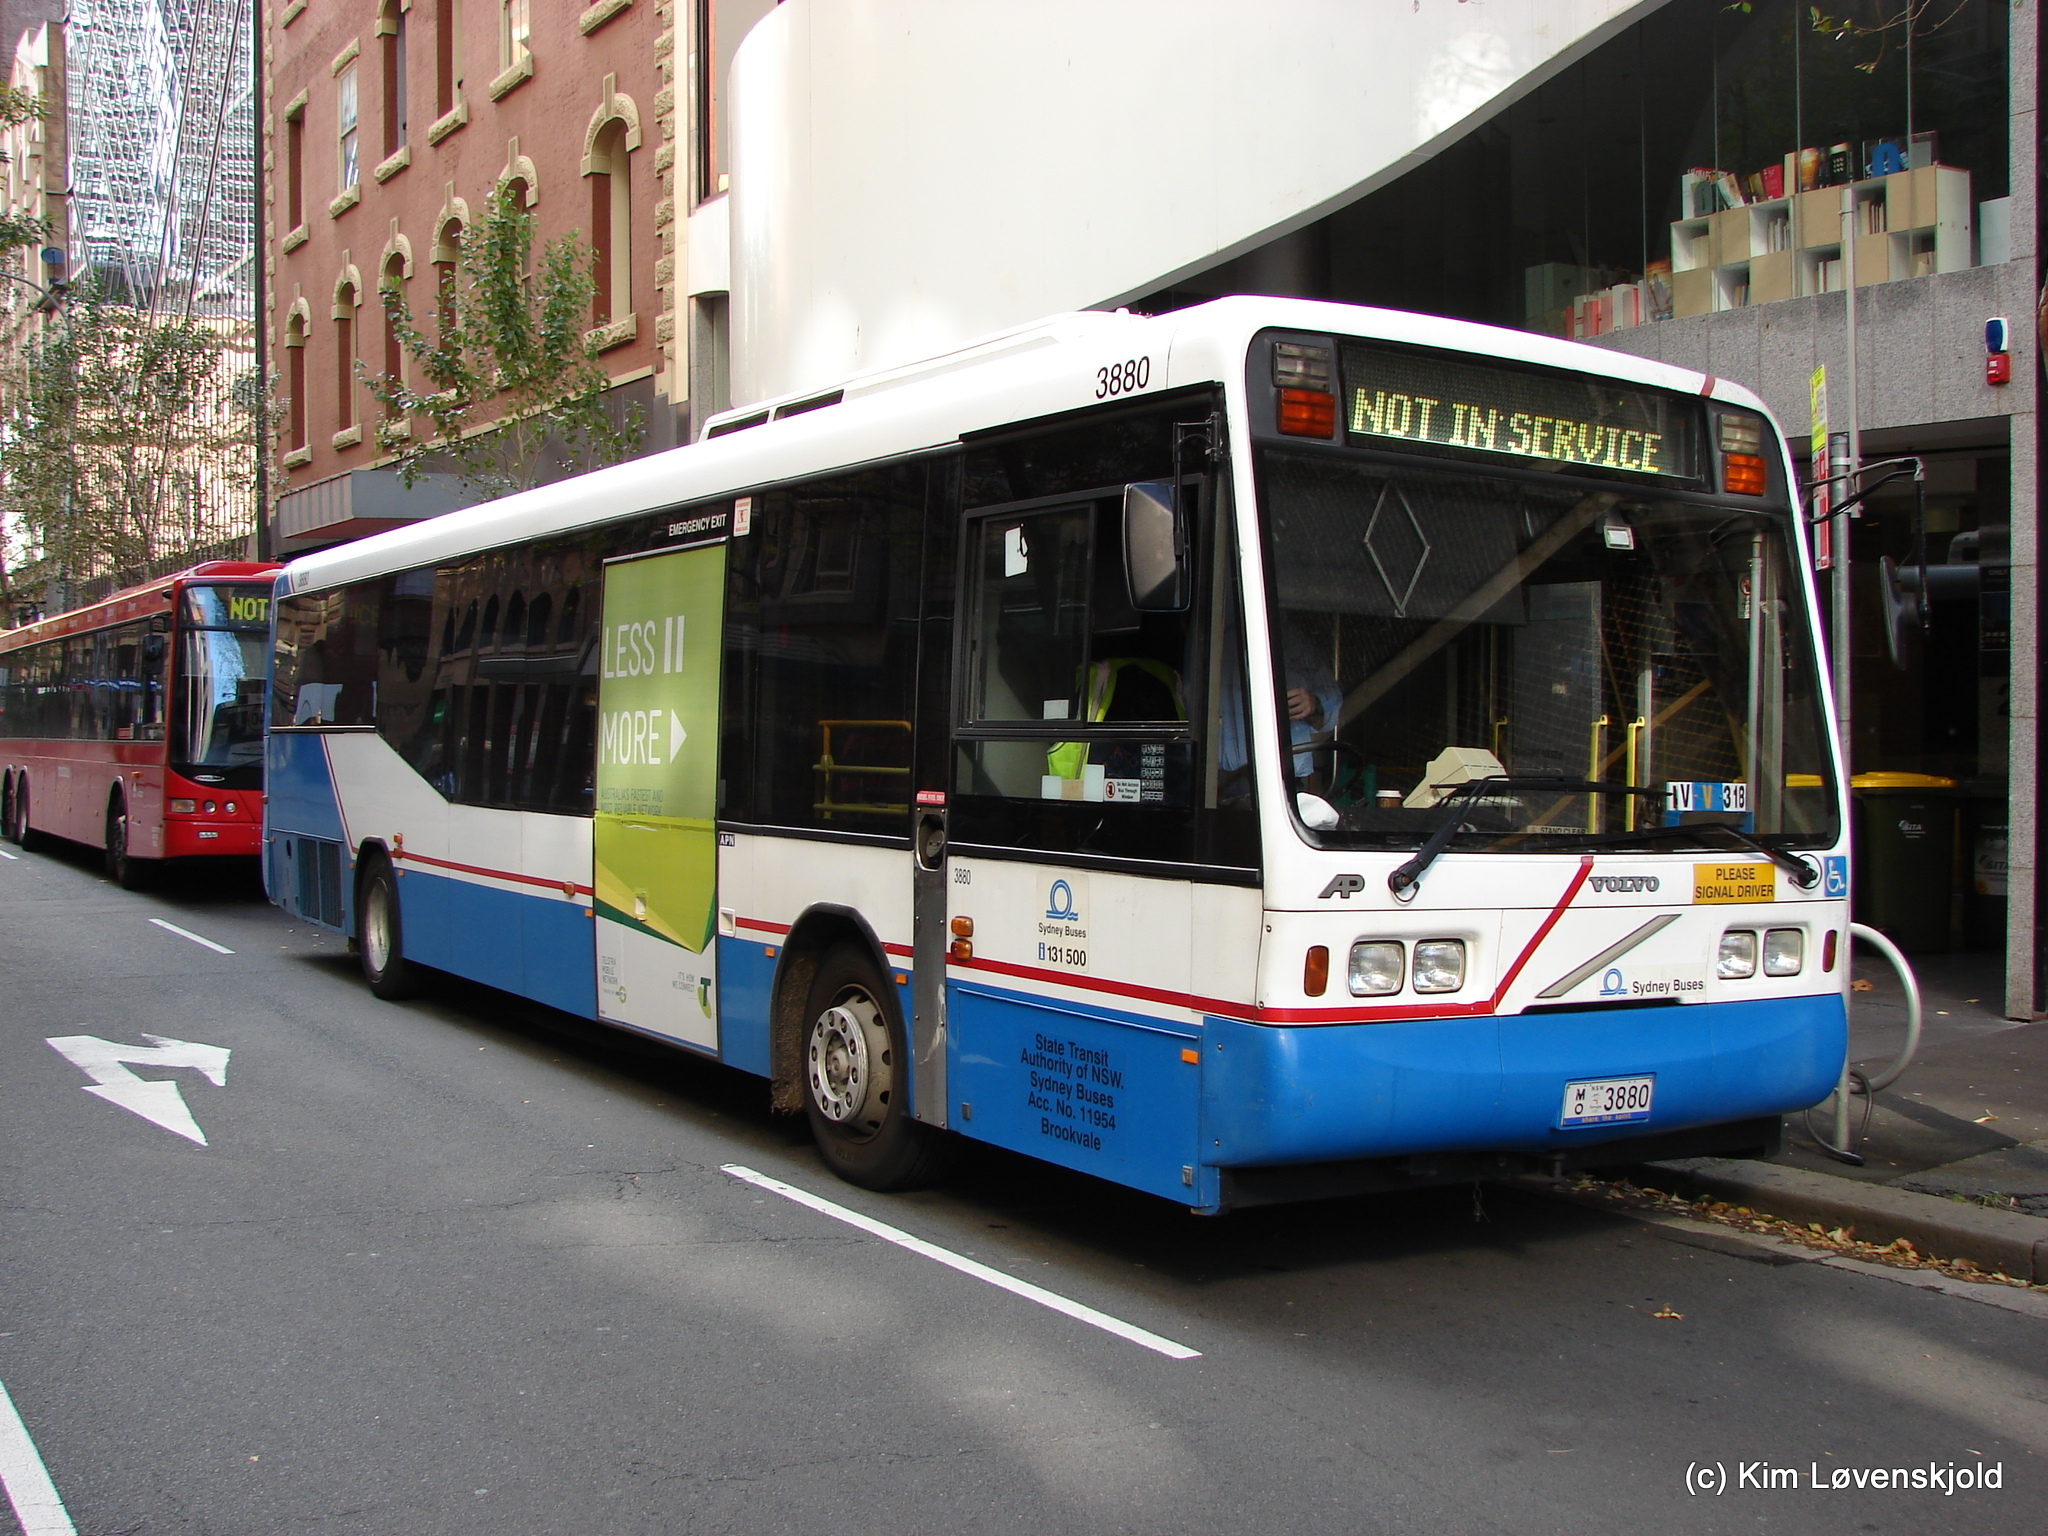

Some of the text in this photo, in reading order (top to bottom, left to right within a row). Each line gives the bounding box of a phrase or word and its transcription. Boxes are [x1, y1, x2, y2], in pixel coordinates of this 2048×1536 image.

[1095, 355, 1150, 399] 3880
[1352, 387, 1662, 473] NOT IN SERVICE
[669, 513, 727, 536] EMERGENCY EXIT
[229, 596, 269, 621] NOT
[603, 620, 656, 679] LESS
[601, 709, 662, 765] MORE
[1723, 785, 1745, 809] 318
[720, 835, 735, 846] APN
[954, 867, 971, 886] 3880
[1318, 874, 1365, 899] AP
[1589, 876, 1660, 893] VOLVO
[1716, 867, 1755, 881] PLEASE
[1695, 884, 1774, 899] SIGNAL DRIVER
[1038, 922, 1087, 938] Sydney Buses
[1047, 945, 1063, 963] 131
[1066, 948, 1087, 966] 500
[1632, 979, 1704, 997] Sydney Buses
[1035, 1033, 1109, 1067] State Transit
[1020, 1048, 1124, 1090] Authority of NSW.
[1030, 1071, 1114, 1109] Sydney Buses
[1604, 1084, 1649, 1111] 3880
[1027, 1091, 1116, 1131] Acc. No. 11954
[1041, 1117, 1101, 1151] Brookvale
